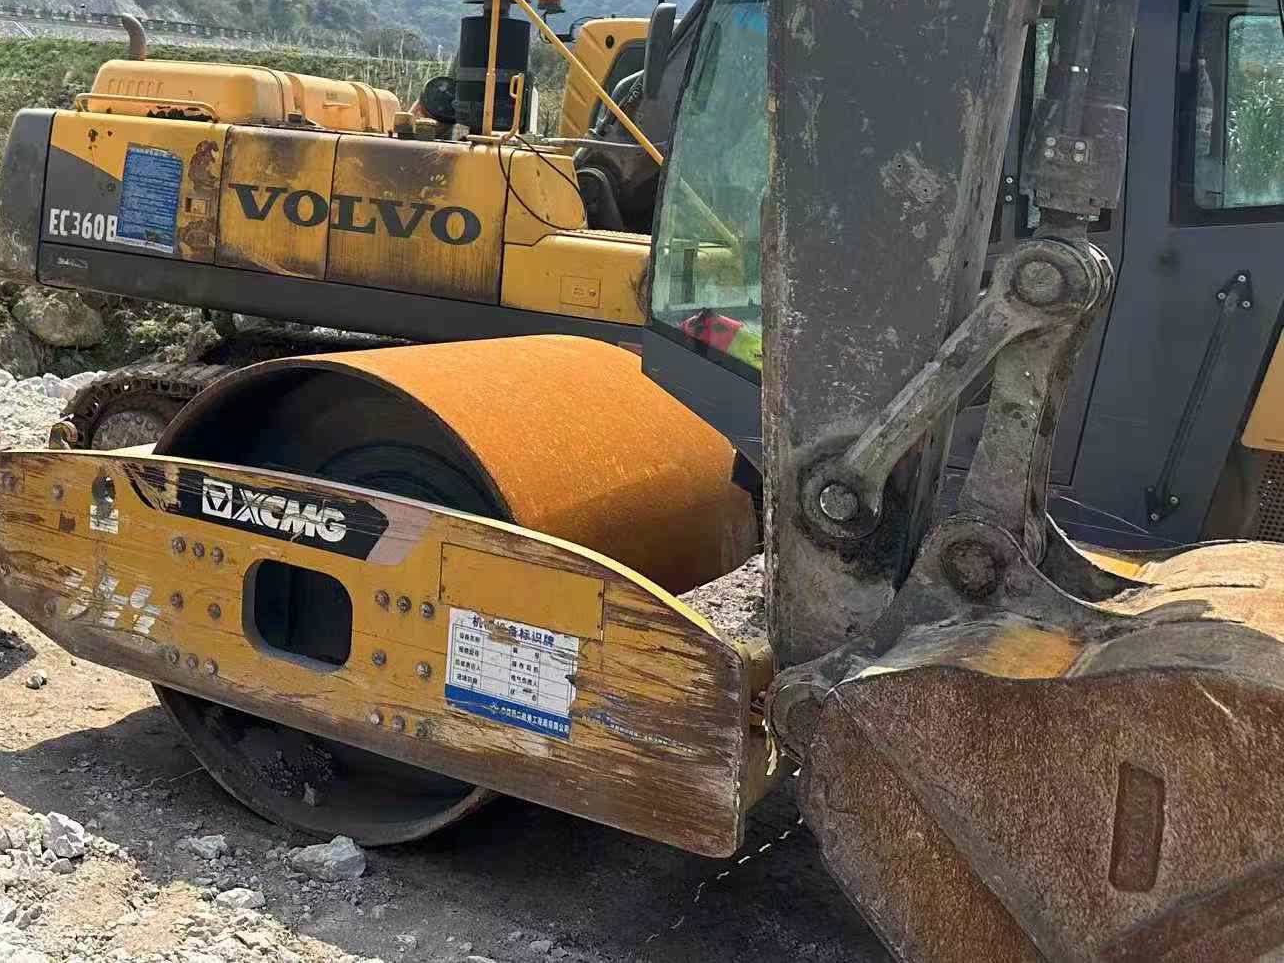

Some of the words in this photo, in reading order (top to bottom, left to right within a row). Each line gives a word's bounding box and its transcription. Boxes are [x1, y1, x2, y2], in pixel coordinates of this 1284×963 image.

[49, 208, 118, 243] EC360B
[228, 182, 482, 246] VOLVO
[232, 488, 348, 543] XCMG
[471, 615, 555, 648] 机备标识牌
